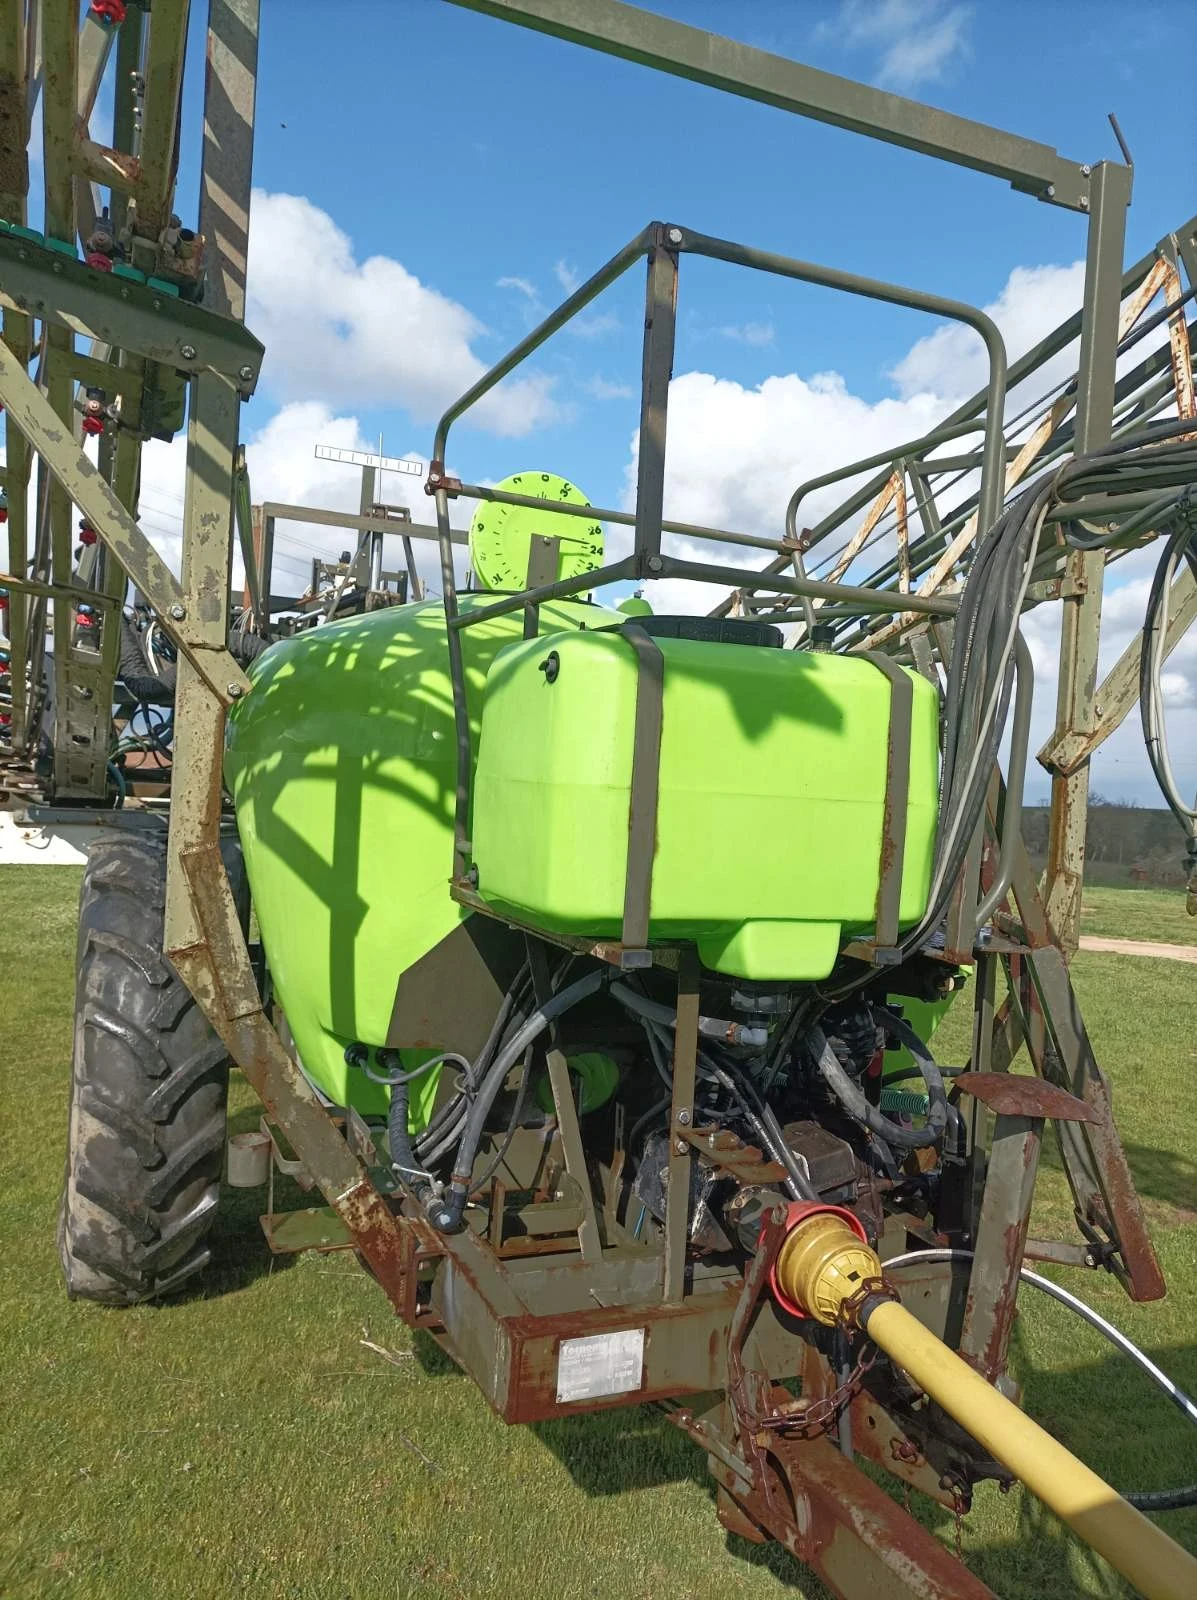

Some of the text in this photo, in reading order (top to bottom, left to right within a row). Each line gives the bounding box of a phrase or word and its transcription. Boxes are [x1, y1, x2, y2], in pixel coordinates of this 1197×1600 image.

[512, 476, 522, 484] 2
[541, 474, 550, 482] 0
[588, 525, 602, 536] 26
[589, 545, 604, 556] 24
